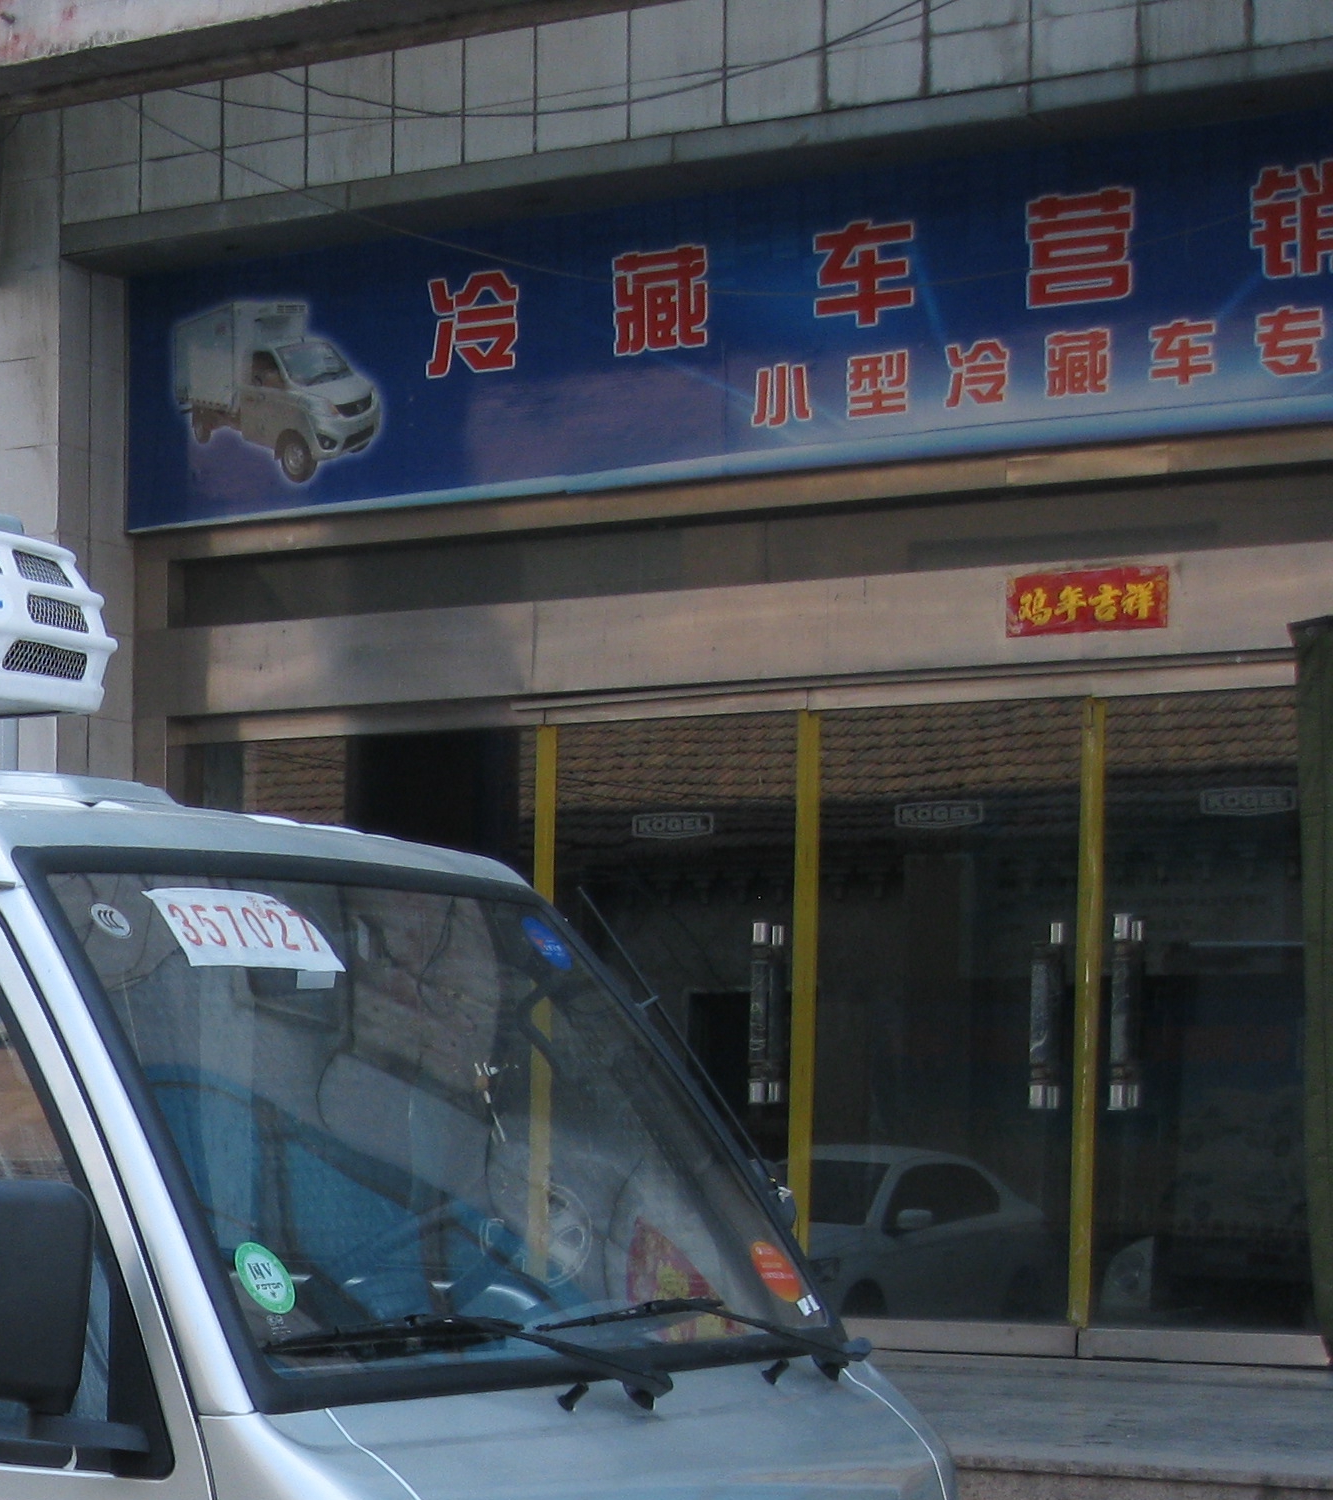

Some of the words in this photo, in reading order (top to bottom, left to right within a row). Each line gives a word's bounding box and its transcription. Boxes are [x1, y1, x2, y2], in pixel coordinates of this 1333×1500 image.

[752, 305, 1325, 428] 小型冷藏车专
[1018, 581, 1154, 626] 鸡年吉祥
[167, 903, 320, 952] 357027
